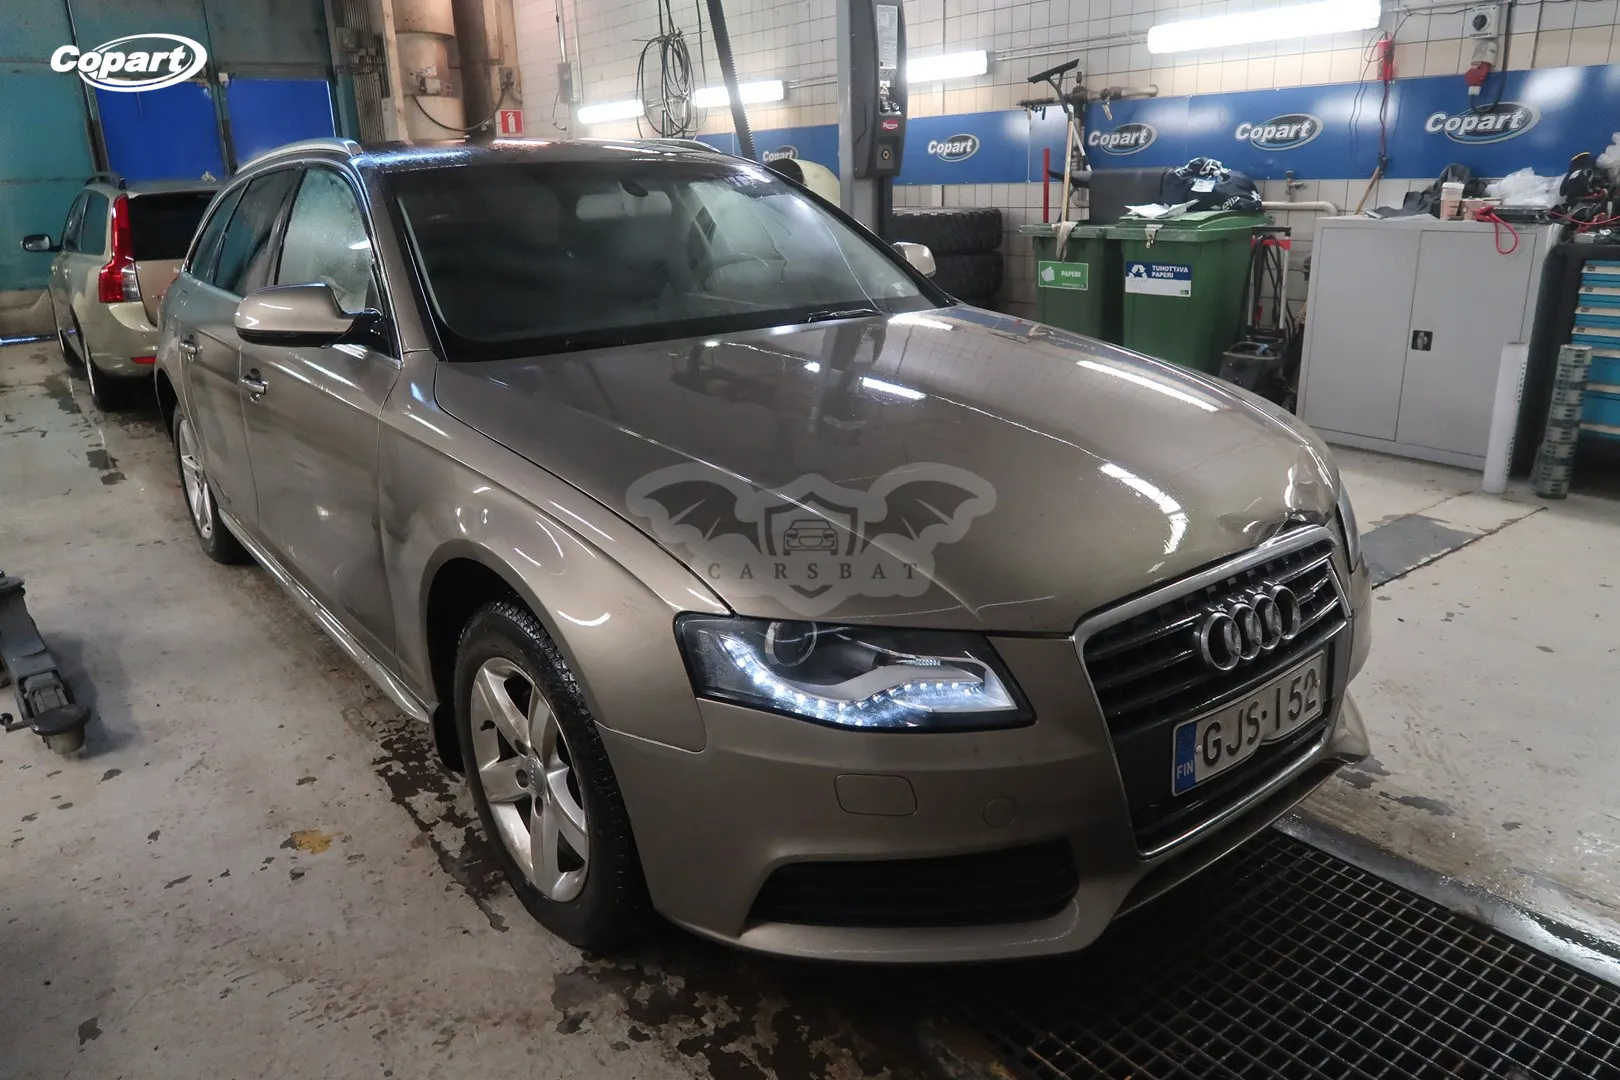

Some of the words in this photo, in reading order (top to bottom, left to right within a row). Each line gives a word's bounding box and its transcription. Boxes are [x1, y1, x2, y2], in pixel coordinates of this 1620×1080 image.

[1235, 120, 1312, 143] Copart
[1425, 109, 1524, 136] Copart
[928, 139, 972, 156] Copart
[1088, 129, 1148, 148] Copart
[1061, 270, 1082, 278] PAPERI
[1202, 667, 1318, 767] GJS-152
[1176, 760, 1194, 780] FIN
